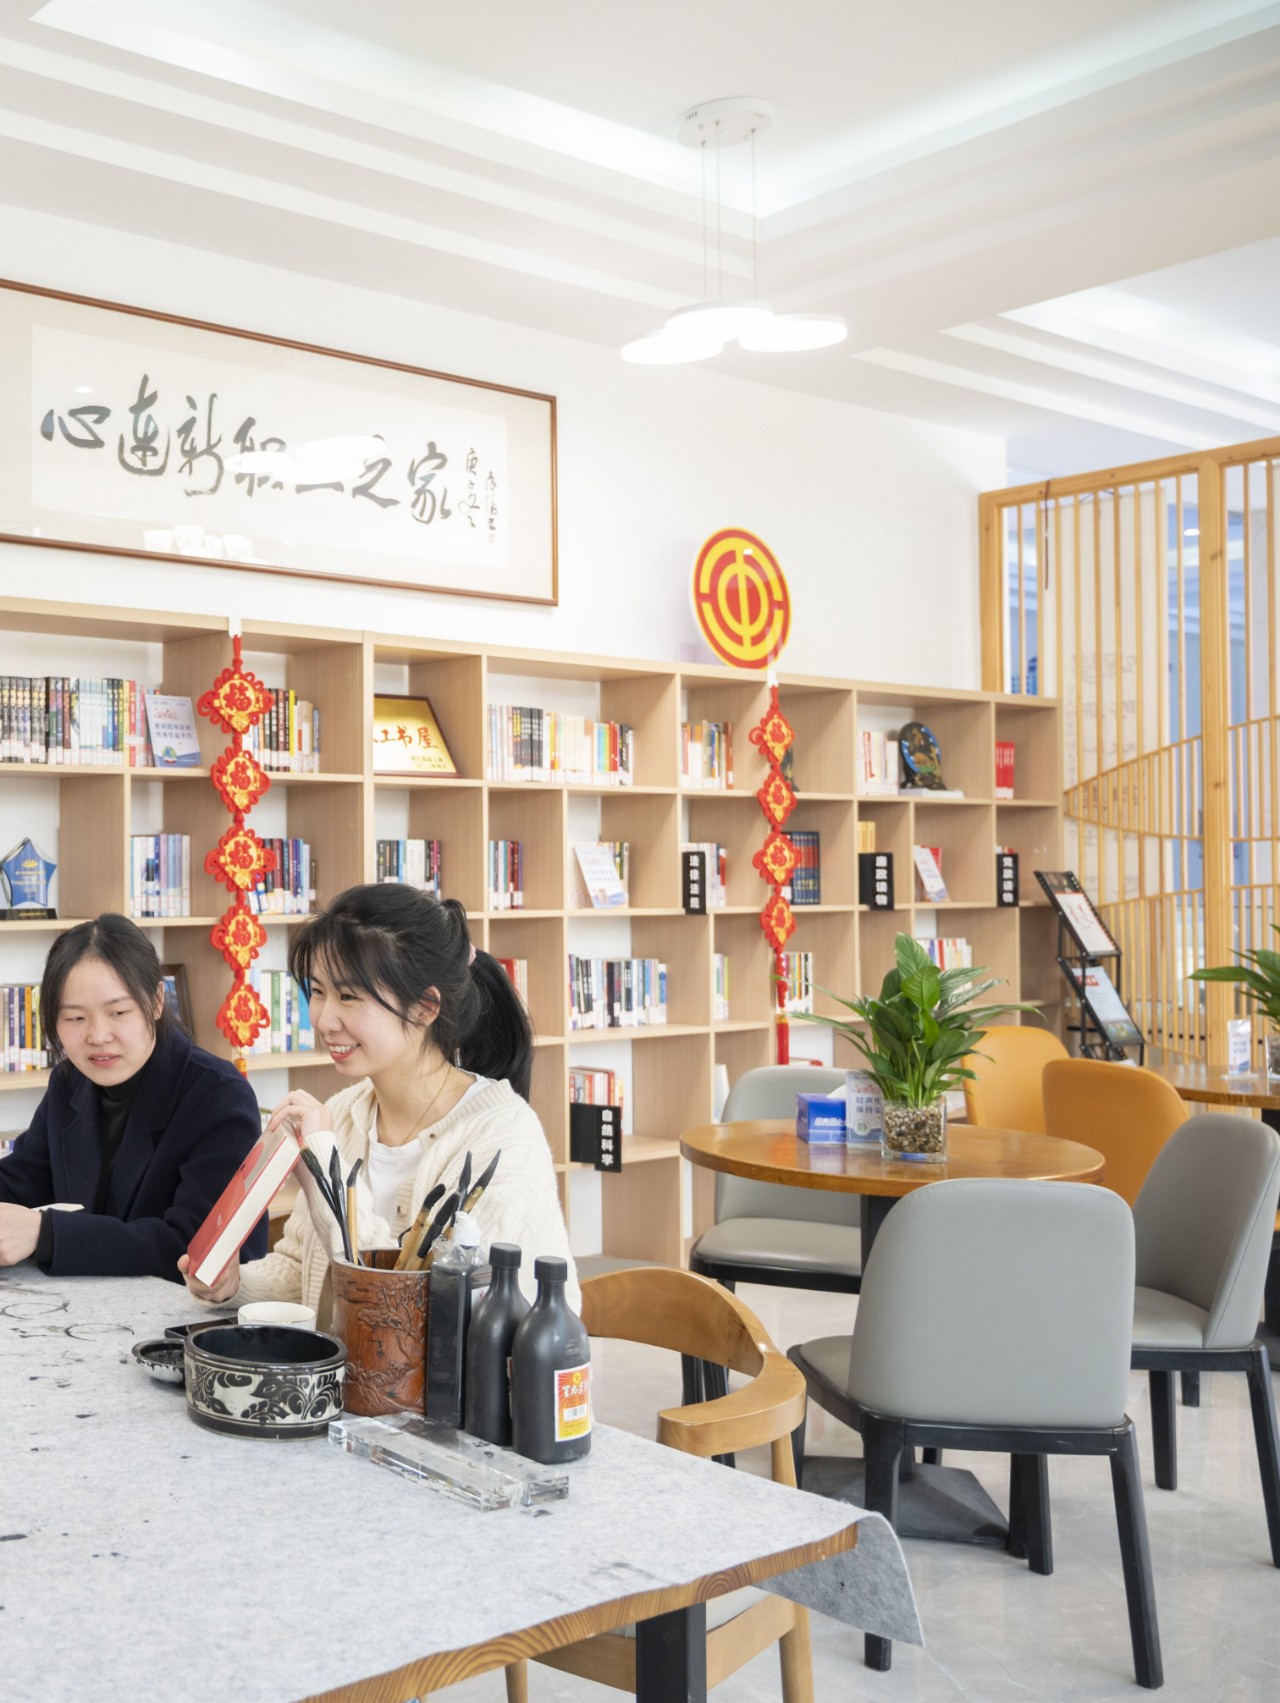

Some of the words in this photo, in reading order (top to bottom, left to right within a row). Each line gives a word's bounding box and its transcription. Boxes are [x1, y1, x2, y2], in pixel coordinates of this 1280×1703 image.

[223, 682, 252, 710] 福
[373, 725, 439, 749] 工书屋
[229, 760, 251, 790] 福
[228, 840, 255, 869] 福
[601, 1109, 614, 1167] 自然科学
